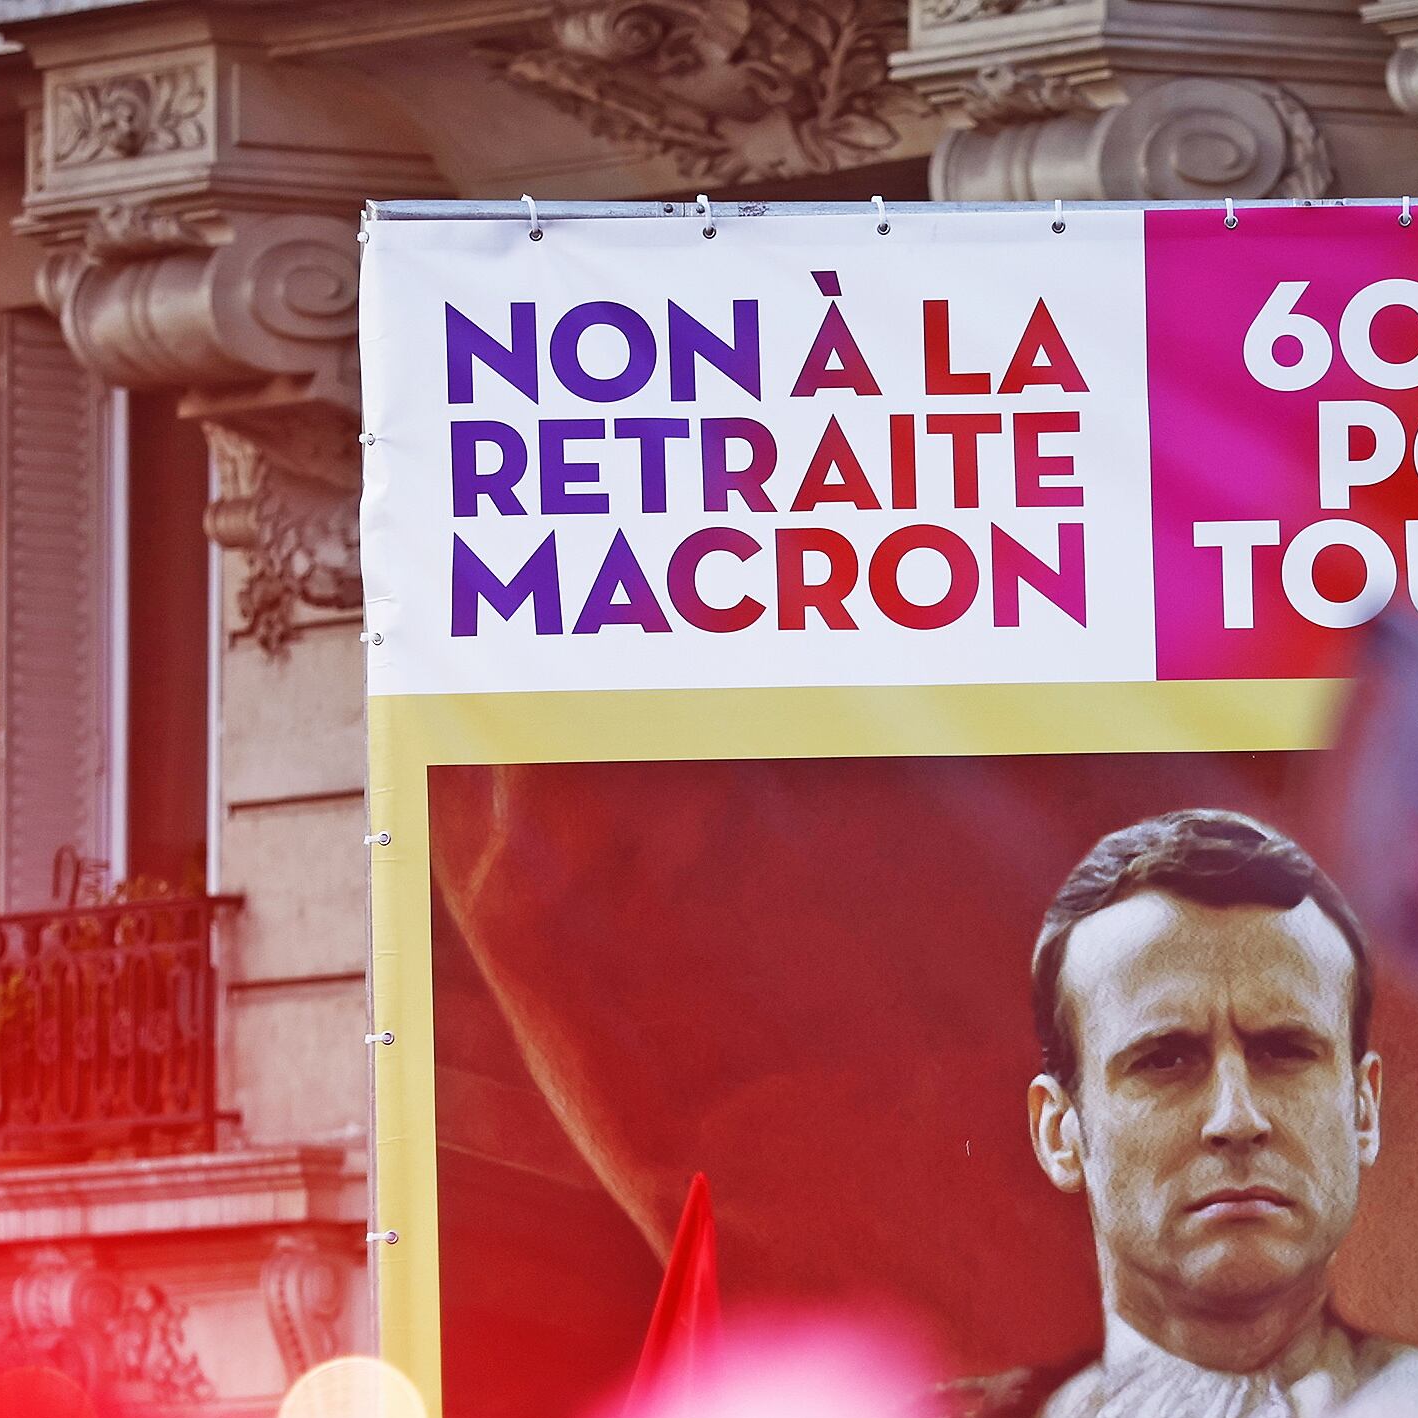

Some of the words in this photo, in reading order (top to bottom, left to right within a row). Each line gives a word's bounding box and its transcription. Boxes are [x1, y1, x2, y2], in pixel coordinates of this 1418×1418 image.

[444, 299, 762, 406] NON
[790, 270, 883, 398] À
[922, 296, 1091, 396] LA
[450, 411, 1084, 518] RETRAITE
[450, 521, 1087, 638] MACRON
